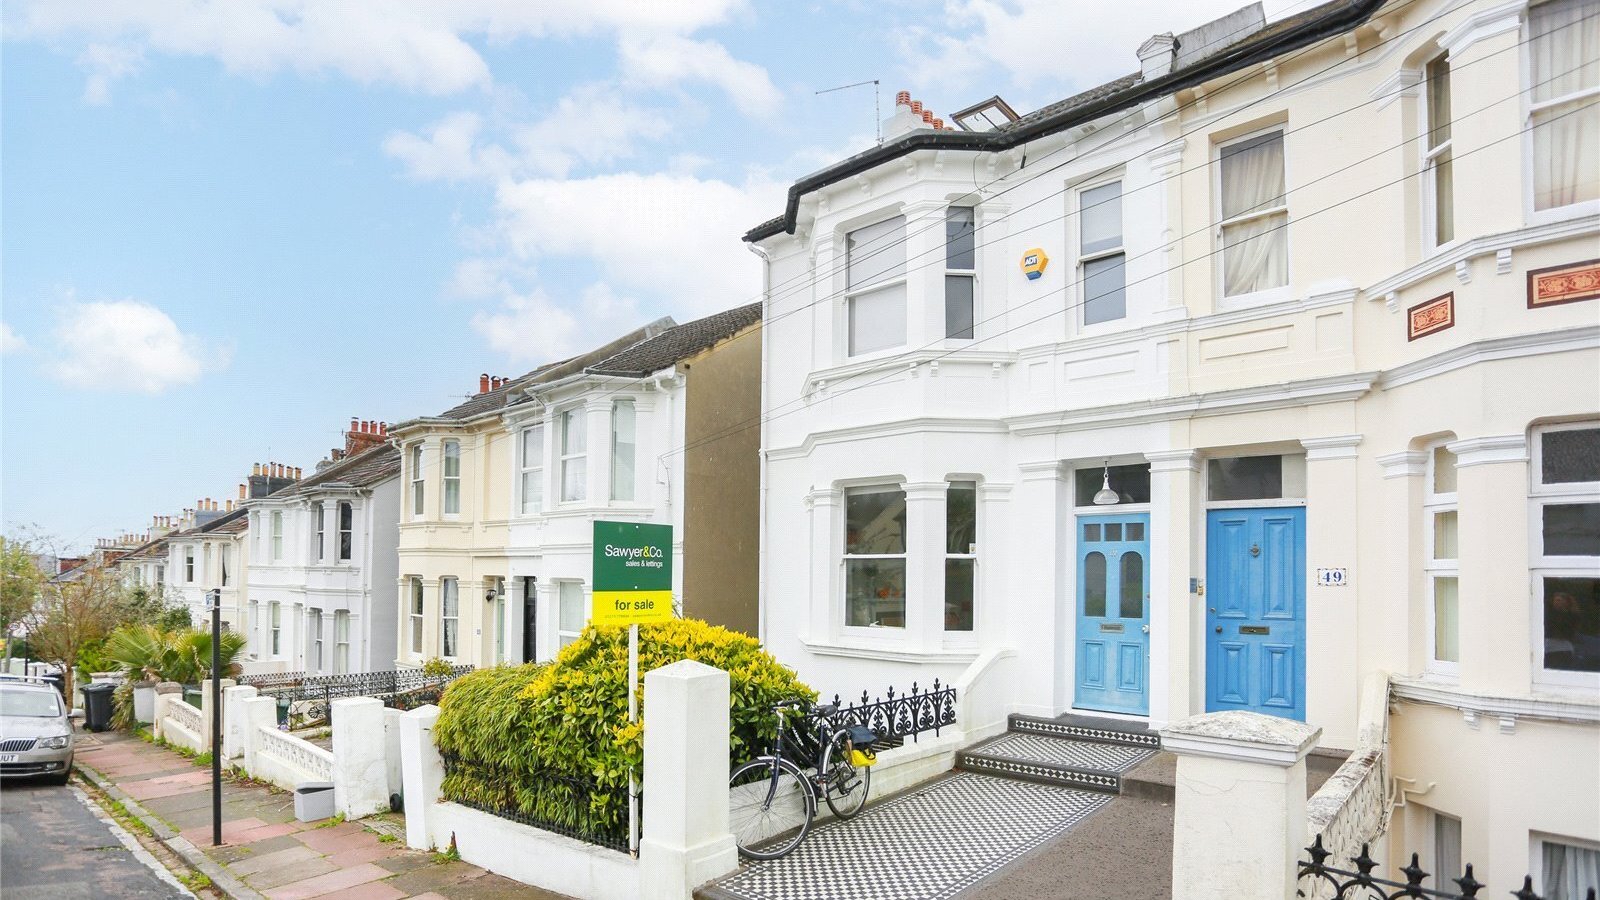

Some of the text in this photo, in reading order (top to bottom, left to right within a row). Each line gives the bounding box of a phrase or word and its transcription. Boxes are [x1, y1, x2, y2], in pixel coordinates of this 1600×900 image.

[1026, 256, 1037, 265] ADT
[605, 544, 663, 560] Sawyer&Co.
[646, 560, 663, 569] lettings
[1322, 571, 1342, 583] 49
[615, 599, 654, 611] for sale
